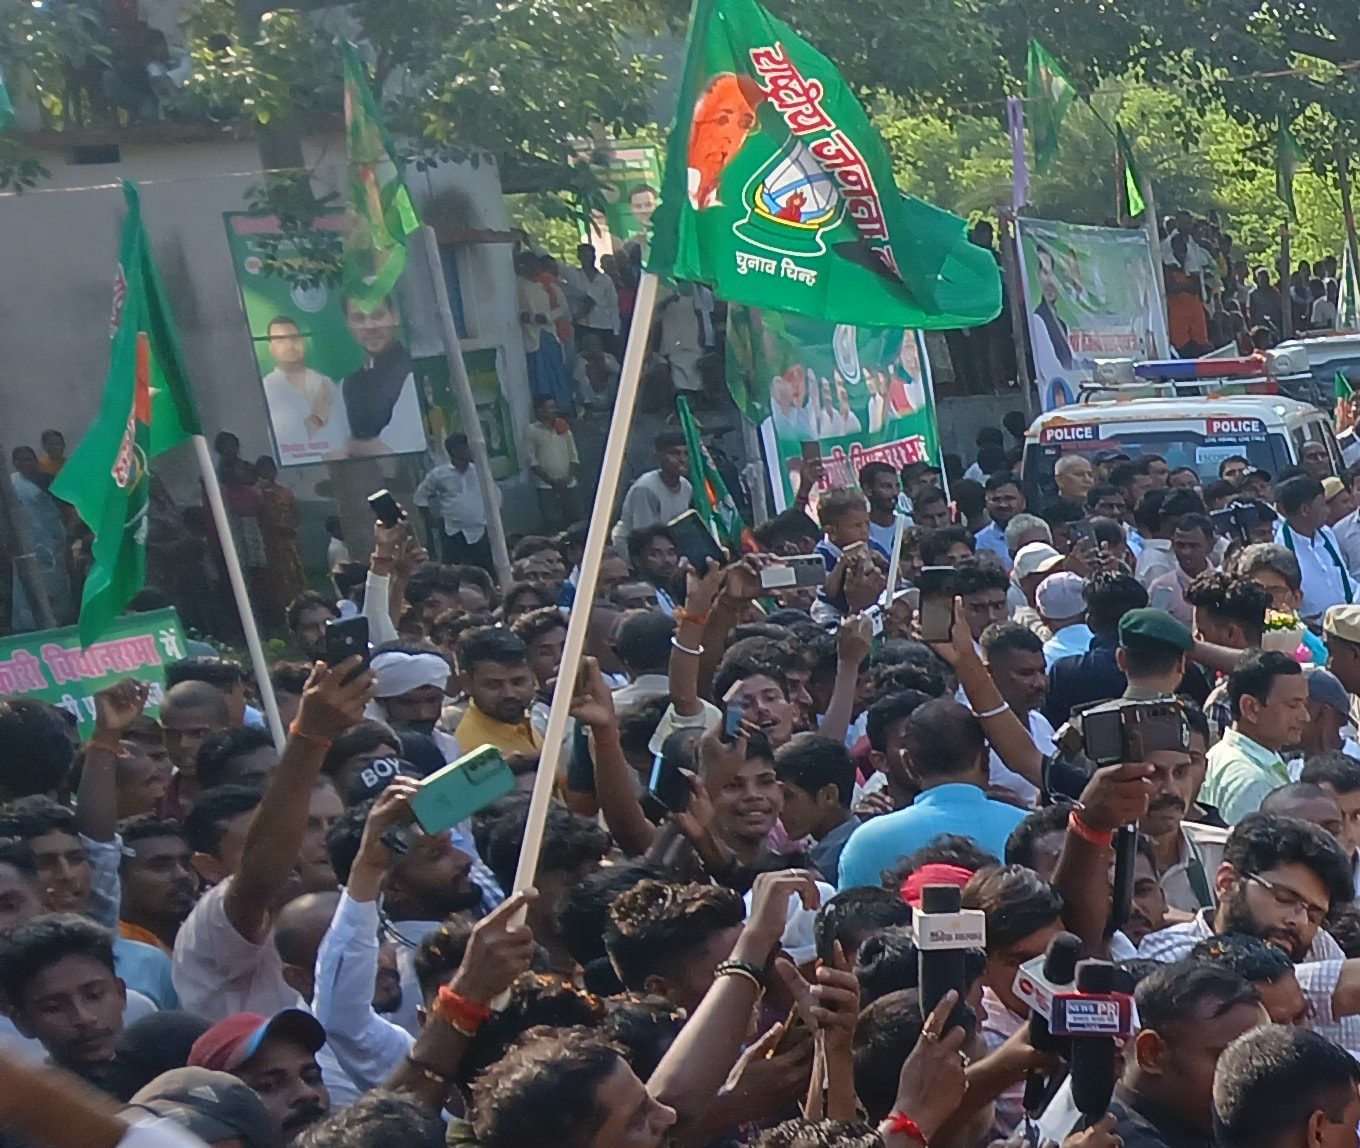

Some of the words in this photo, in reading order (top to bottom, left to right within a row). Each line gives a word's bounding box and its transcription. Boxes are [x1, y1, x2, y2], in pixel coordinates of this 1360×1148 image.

[750, 41, 835, 136] राष्ट्रीय
[809, 130, 889, 241] जनता
[736, 251, 777, 275] चुनाव
[780, 257, 818, 287] चिन्ह
[1046, 426, 1093, 441] POLICE
[1212, 420, 1260, 433] POLICE
[159, 627, 184, 659] में
[361, 757, 401, 788] BOY
